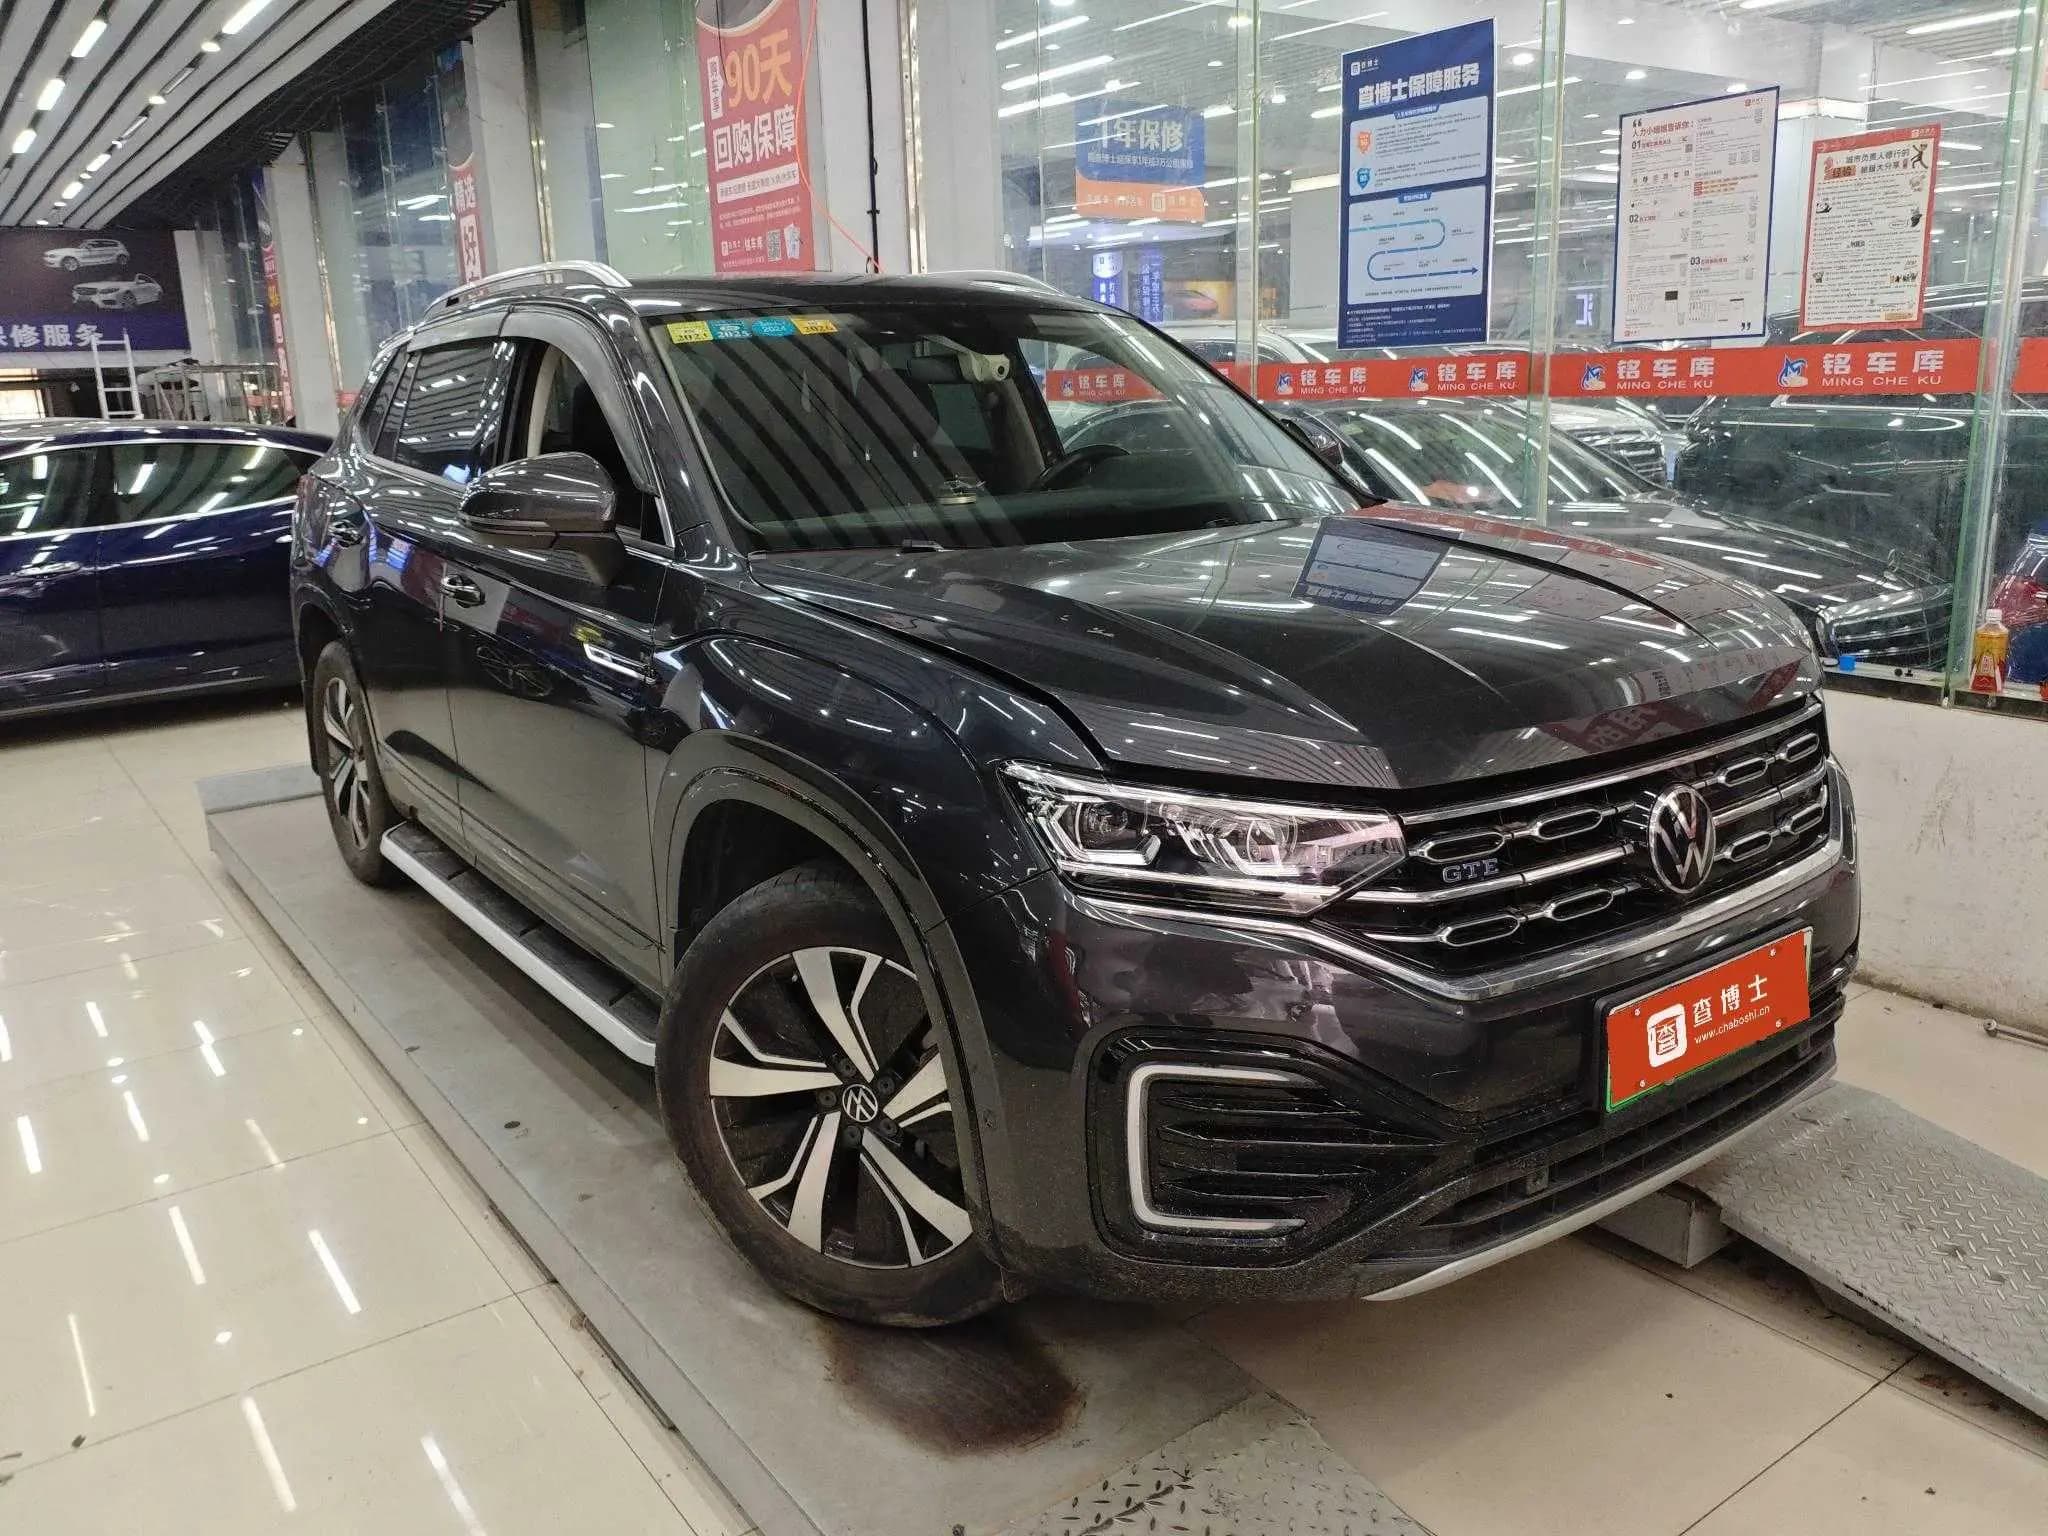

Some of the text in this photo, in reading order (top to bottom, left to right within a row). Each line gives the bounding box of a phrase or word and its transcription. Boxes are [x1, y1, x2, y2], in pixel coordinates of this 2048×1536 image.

[725, 28, 793, 107] 90天
[1358, 62, 1480, 111] 查博士保障服务
[713, 104, 797, 173] 回购保障
[1690, 256, 1700, 265] 03
[1437, 361, 1517, 382] 铭车库
[1615, 357, 1715, 380] 铭车库
[1822, 349, 1944, 375] 铭车库
[1300, 367, 1368, 385] 铭车库
[1437, 382, 1517, 391] MING CHE KU
[1616, 379, 1713, 389] MING CHE KU
[1822, 375, 1942, 387] MING CHE KU
[1300, 387, 1325, 395] MING
[1328, 386, 1348, 394] CHE
[1442, 858, 1500, 883] GTE
